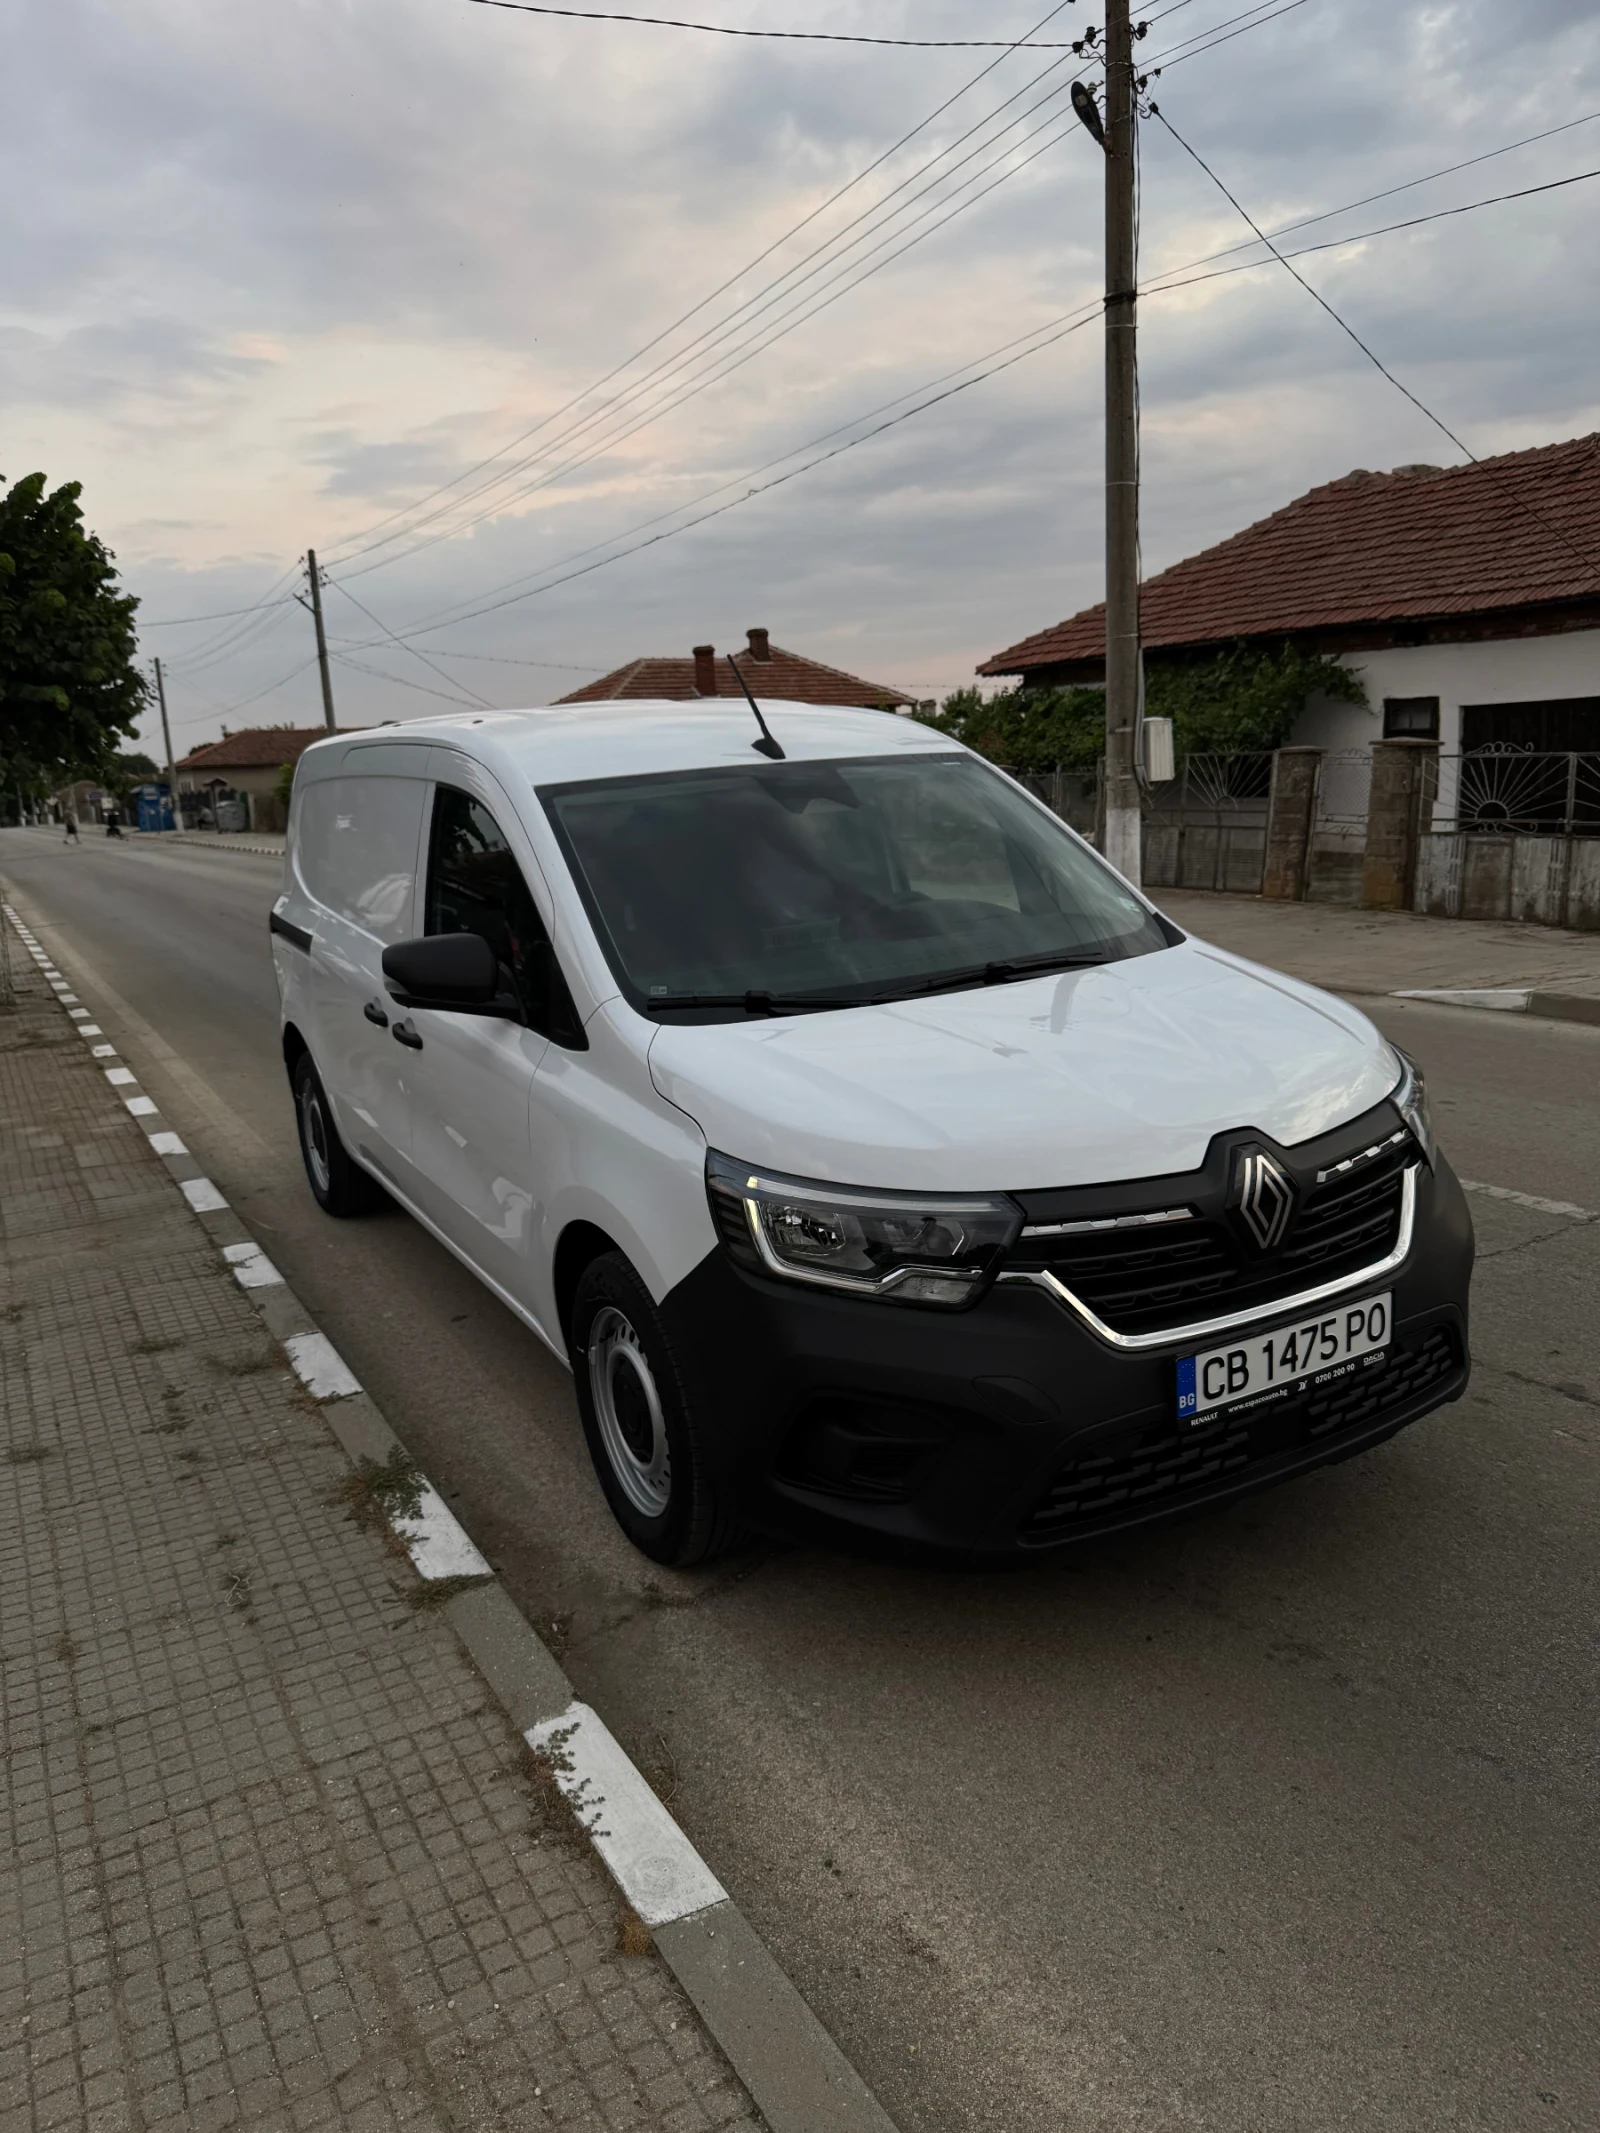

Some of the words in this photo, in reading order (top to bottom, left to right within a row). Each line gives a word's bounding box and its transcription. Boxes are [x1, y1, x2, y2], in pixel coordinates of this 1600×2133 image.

[1202, 1349, 1250, 1400] CB
[1262, 1317, 1339, 1381] 1475
[1345, 1302, 1386, 1353] PO
[1363, 1352, 1385, 1365] DACIA
[1315, 1372, 1332, 1384] 0700
[1333, 1367, 1345, 1377] 200
[1346, 1362, 1356, 1372] 90
[1179, 1392, 1195, 1409] BG
[1228, 1389, 1288, 1412] www.espaceauto.bg
[1191, 1412, 1218, 1426] RENAULT
